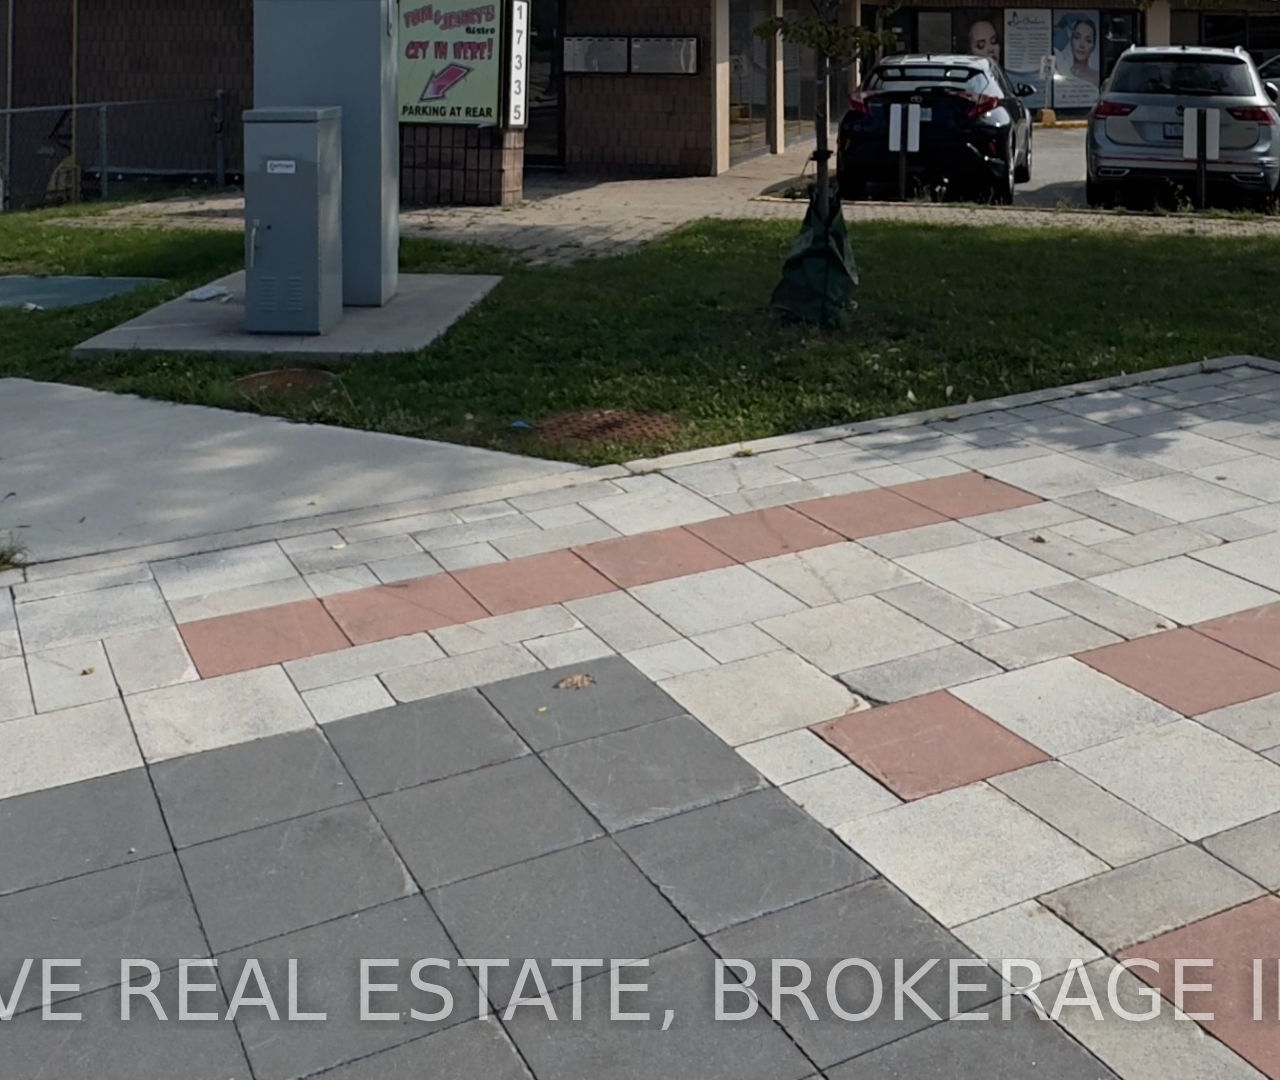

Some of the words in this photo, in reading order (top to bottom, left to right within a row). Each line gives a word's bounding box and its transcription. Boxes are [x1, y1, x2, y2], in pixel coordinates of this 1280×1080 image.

[402, 105, 447, 116] PARKING
[449, 106, 462, 116] AT
[465, 106, 492, 117] REAR
